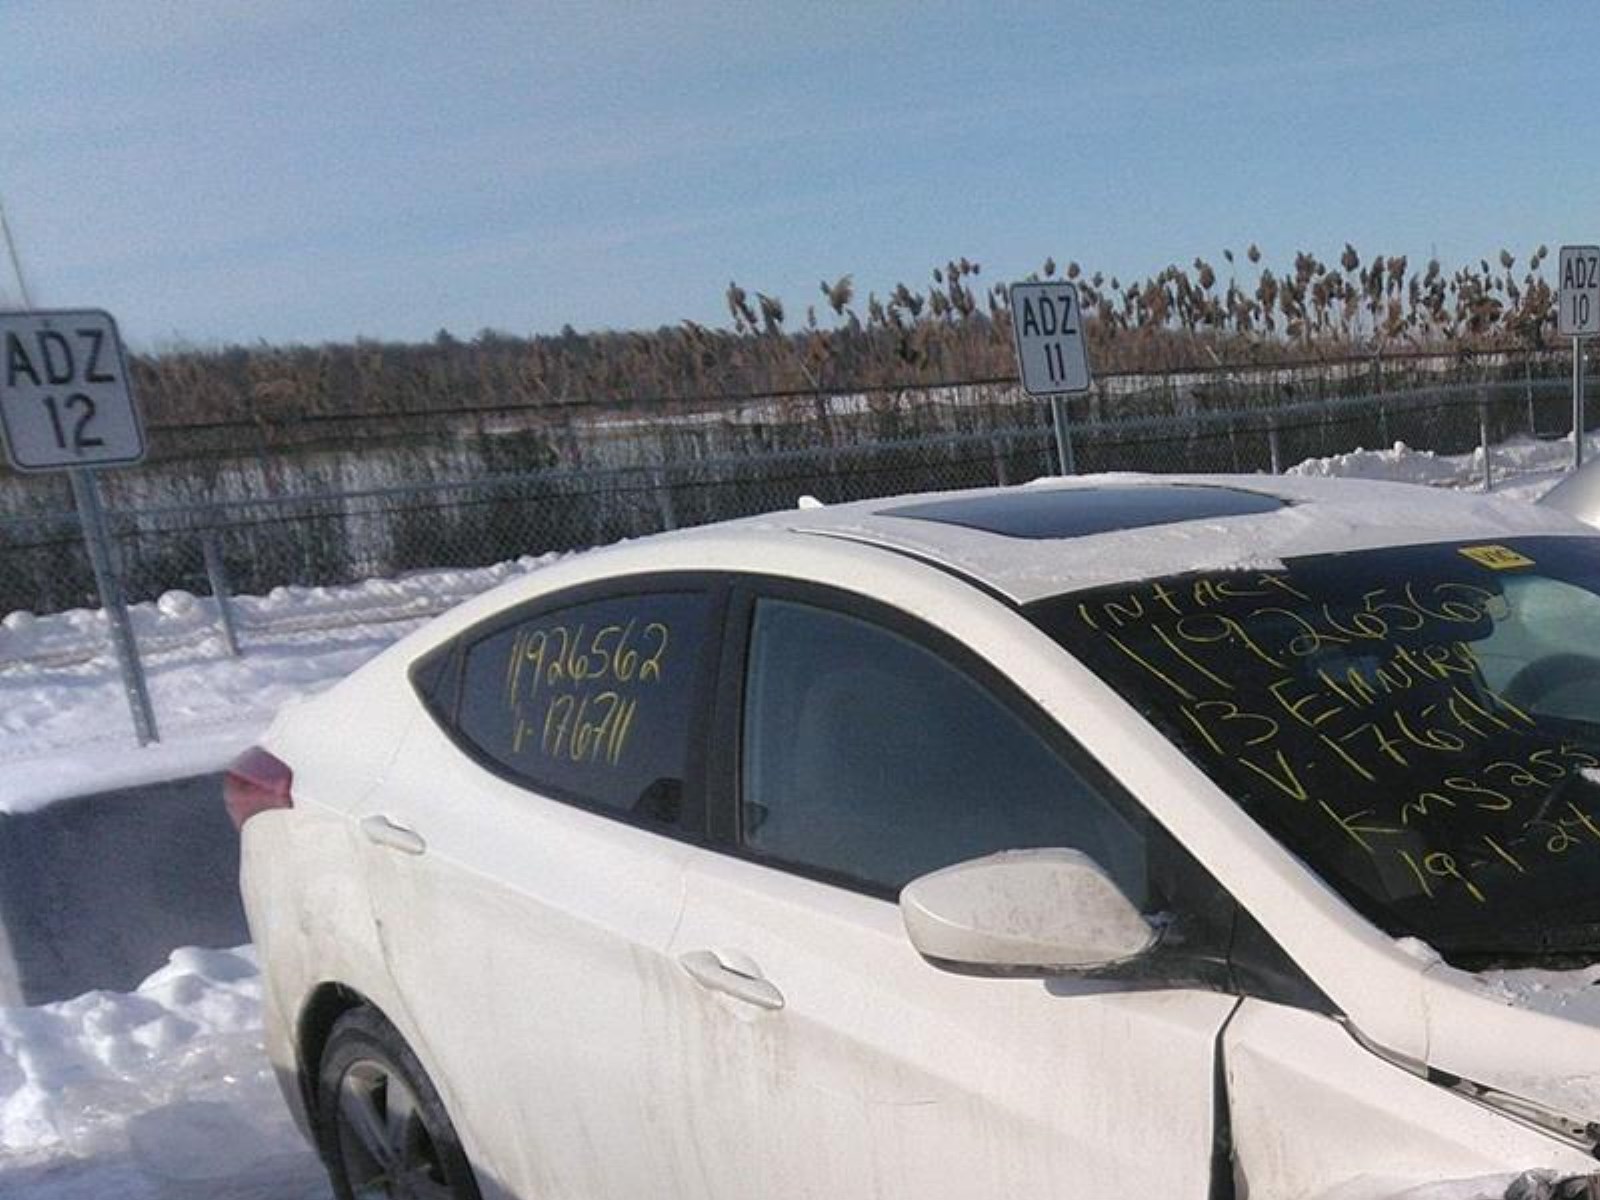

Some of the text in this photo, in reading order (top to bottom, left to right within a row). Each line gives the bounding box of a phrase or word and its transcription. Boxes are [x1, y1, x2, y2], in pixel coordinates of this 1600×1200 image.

[1563, 256, 1598, 290] ADZ
[1023, 295, 1077, 336] ADZ
[1573, 293, 1590, 326] 10
[6, 328, 116, 387] ADZ
[1044, 341, 1065, 381] 11
[43, 392, 105, 448] 12
[508, 616, 669, 704] 11926562
